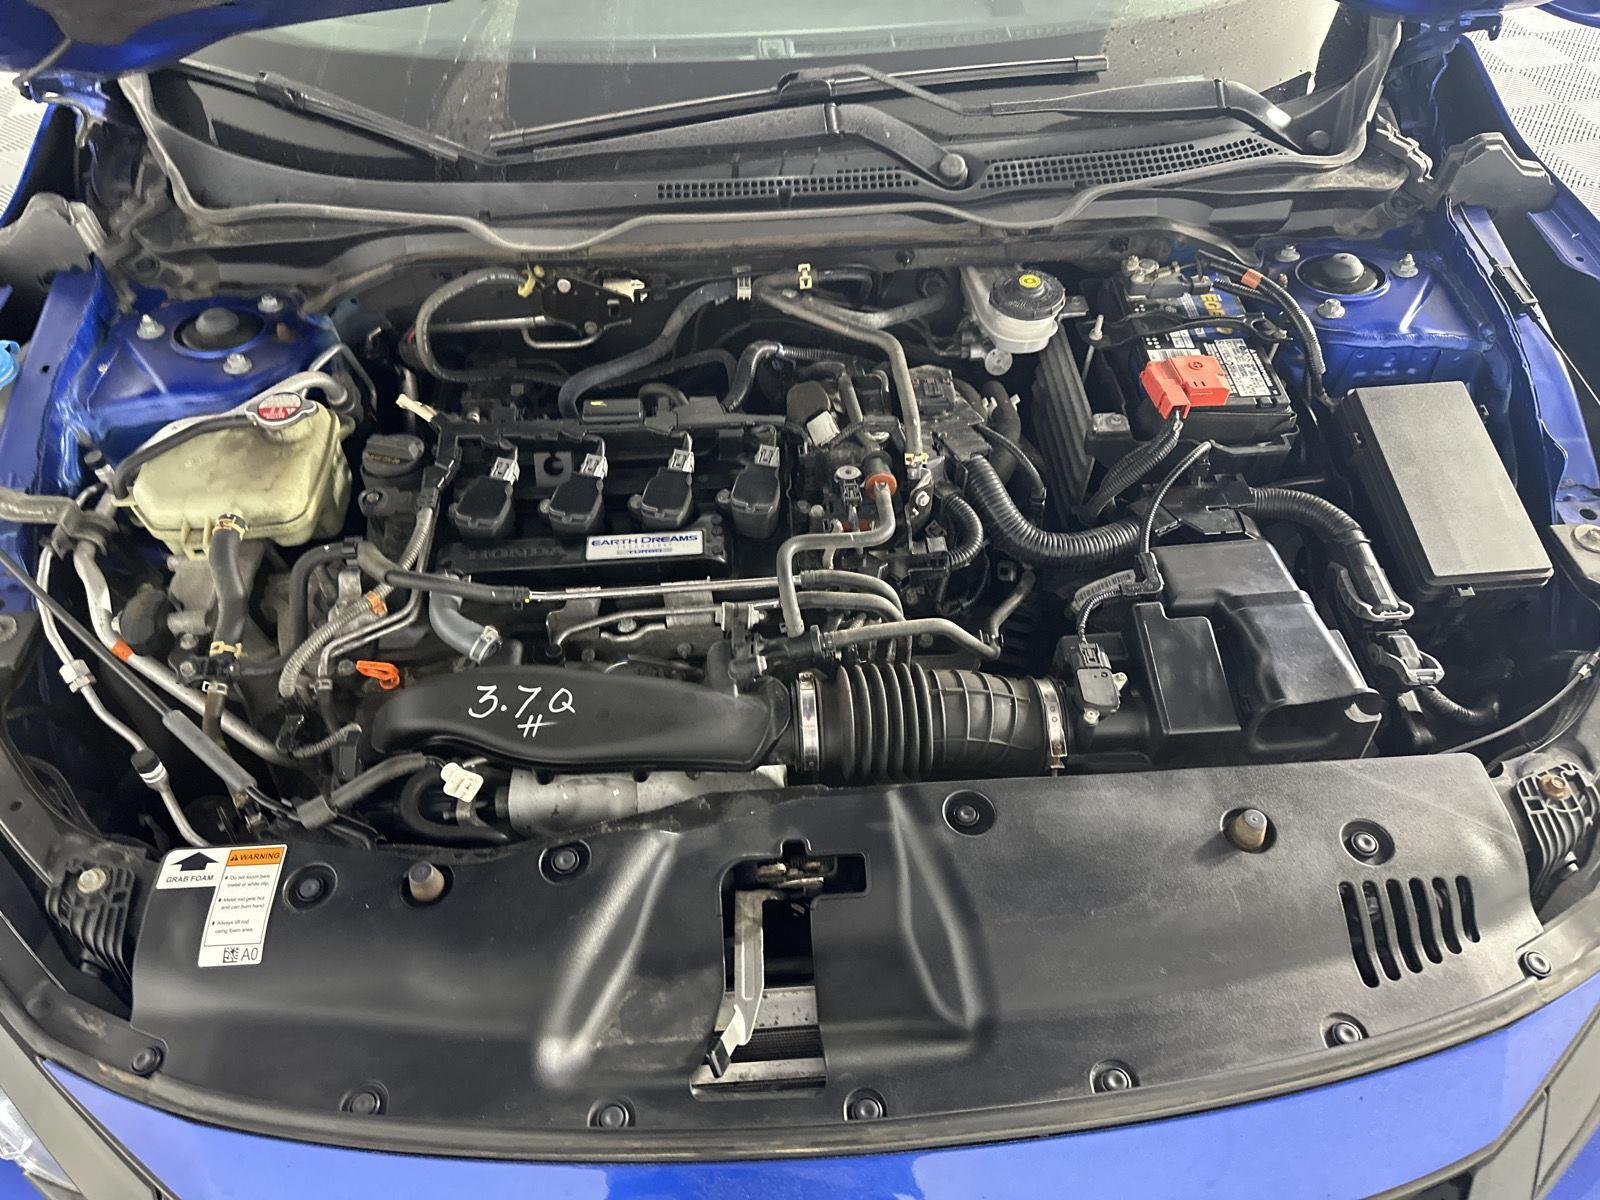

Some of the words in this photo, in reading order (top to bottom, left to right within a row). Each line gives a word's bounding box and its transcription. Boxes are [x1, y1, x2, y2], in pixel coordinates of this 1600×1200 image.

[591, 537, 638, 547] EARTH
[641, 535, 698, 544] DREAMS
[240, 852, 280, 861] WARNING
[166, 875, 188, 883] GRAB
[190, 874, 214, 882] FOAM
